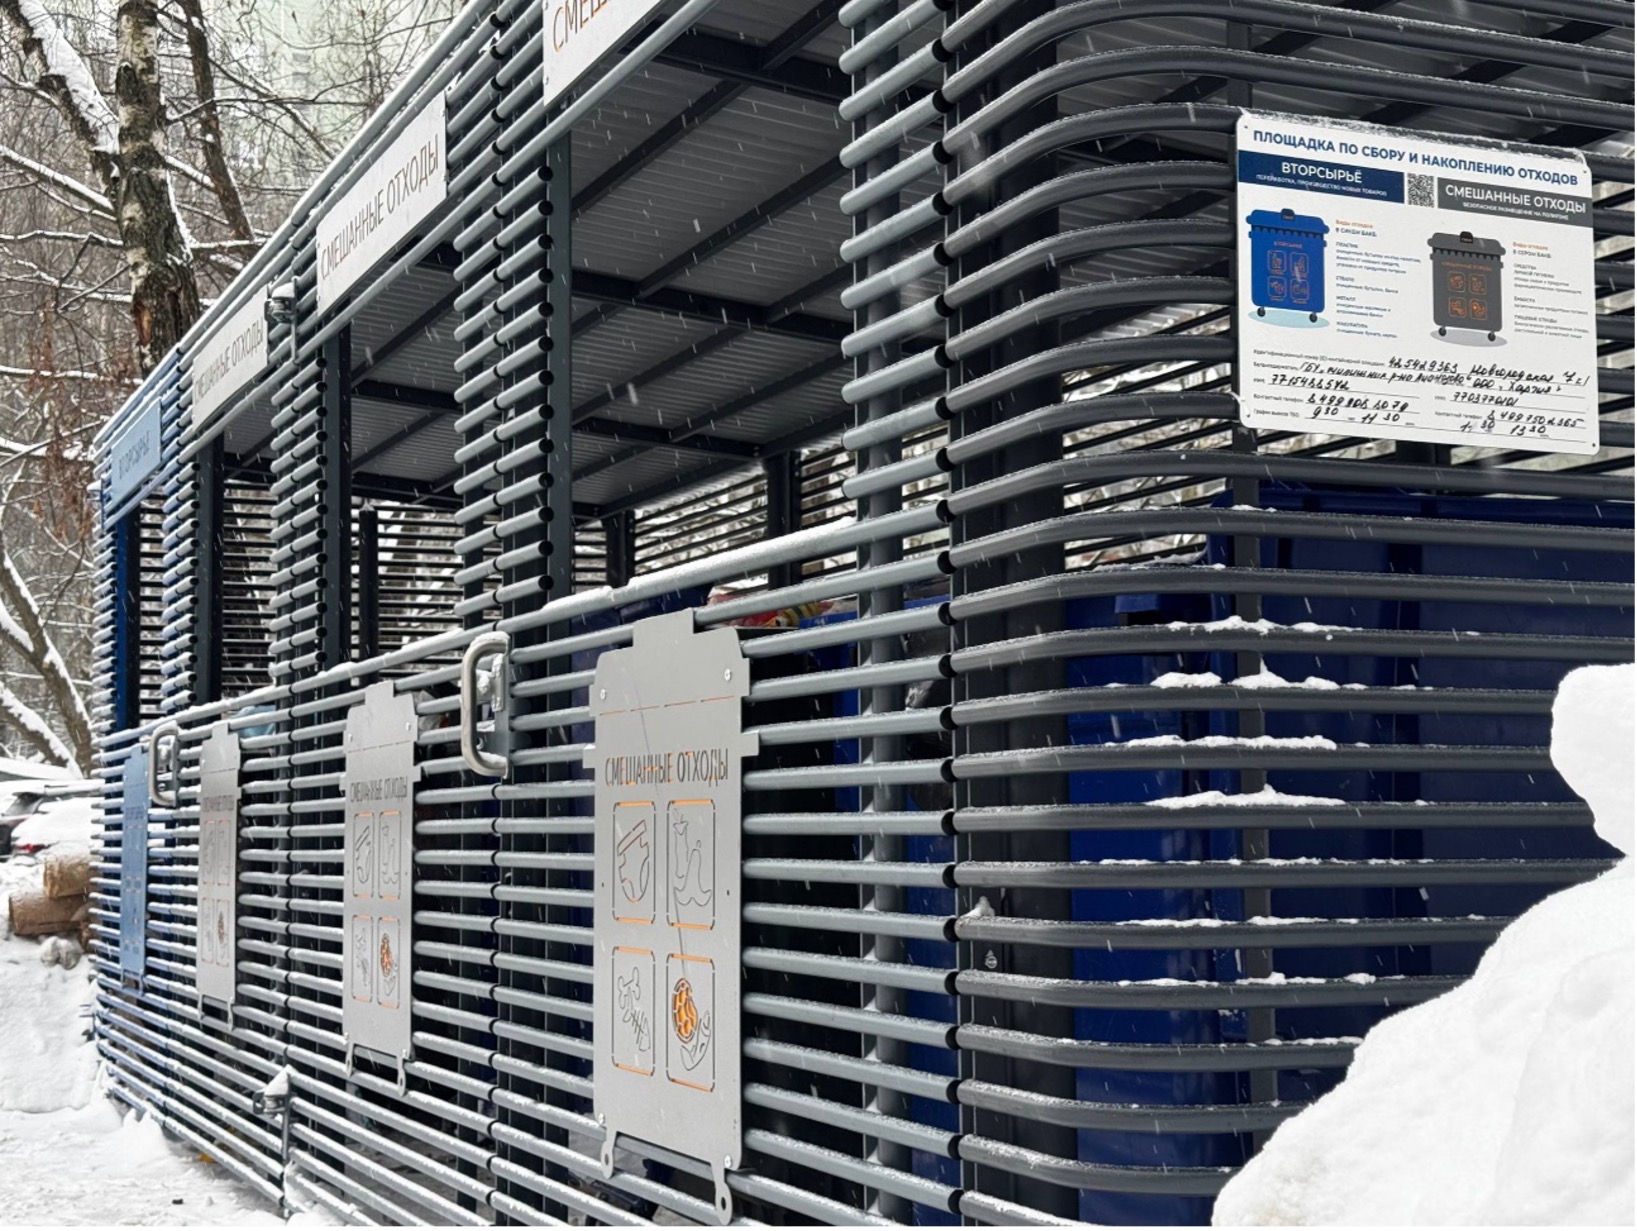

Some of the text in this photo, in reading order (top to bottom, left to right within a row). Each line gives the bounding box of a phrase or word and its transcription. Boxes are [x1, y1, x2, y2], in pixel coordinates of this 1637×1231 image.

[1253, 130, 1578, 186] ПЛОЩАДКА ПО СБОРУ И НАКОПЛЕНИЮ ОТХОДОВ
[1281, 161, 1362, 183] ВТОРСЫРЬЁ
[320, 134, 438, 280] СМЕШАННЫЕ ОТХОДЫ
[1445, 184, 1586, 214] СМЕШАННЫЕ ОТХОДЫ
[232, 317, 263, 367] ОТХОДЫ
[605, 748, 729, 787] СМЕШАННЫЕ ОТХОДЫ
